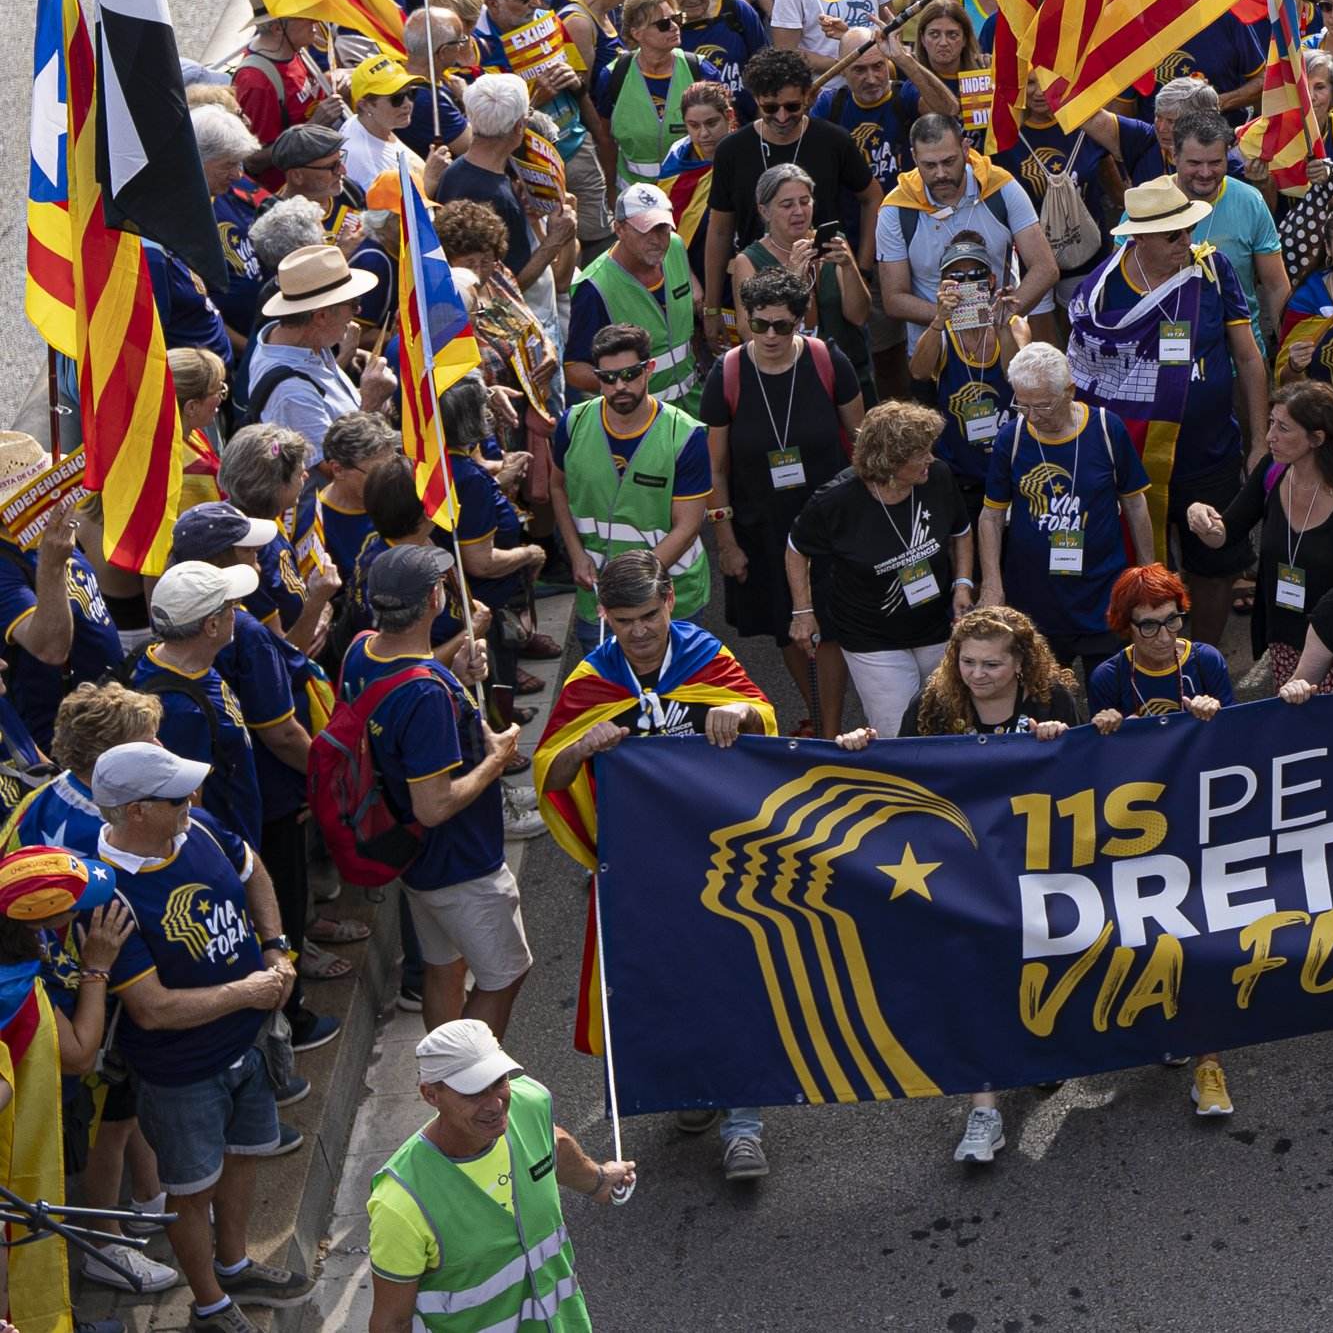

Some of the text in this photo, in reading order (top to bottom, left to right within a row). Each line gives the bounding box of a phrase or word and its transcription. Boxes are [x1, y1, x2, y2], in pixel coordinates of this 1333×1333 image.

[2, 454, 86, 523] INDEPENDÈNC
[1050, 496, 1081, 514] VIA
[1038, 511, 1089, 533] FORA!
[875, 542, 940, 575] INDEPENDÈNCIA
[1011, 782, 1167, 870] 11S
[206, 899, 238, 934] VIA
[207, 912, 250, 965] FORA!
[1020, 921, 1186, 1038] VIA
